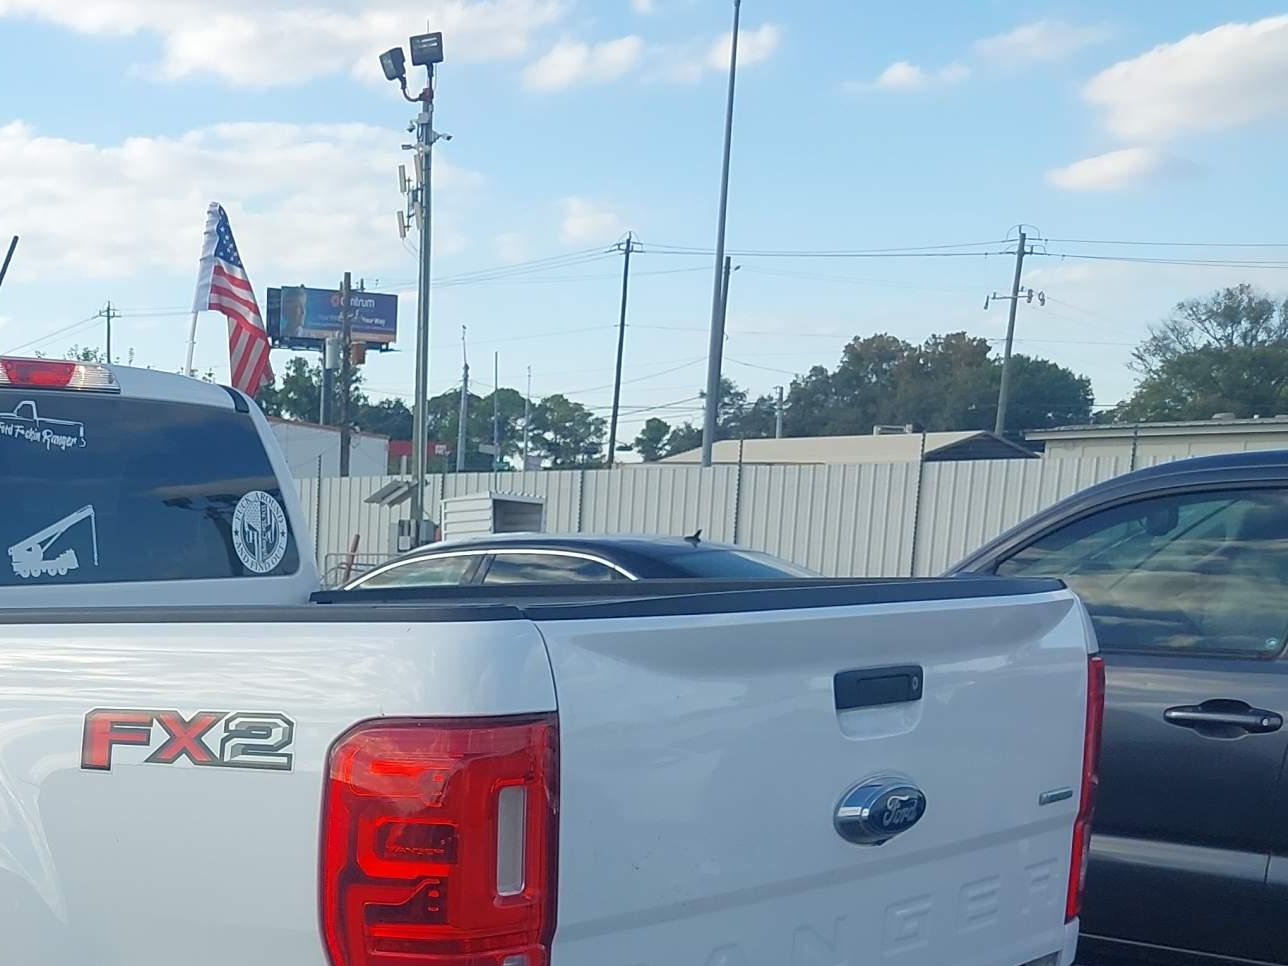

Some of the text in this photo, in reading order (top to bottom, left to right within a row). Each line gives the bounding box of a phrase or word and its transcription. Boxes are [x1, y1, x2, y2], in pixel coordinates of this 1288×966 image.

[42, 429, 77, 450] Ranger
[255, 492, 284, 524] AROUND
[80, 706, 295, 772] FX2
